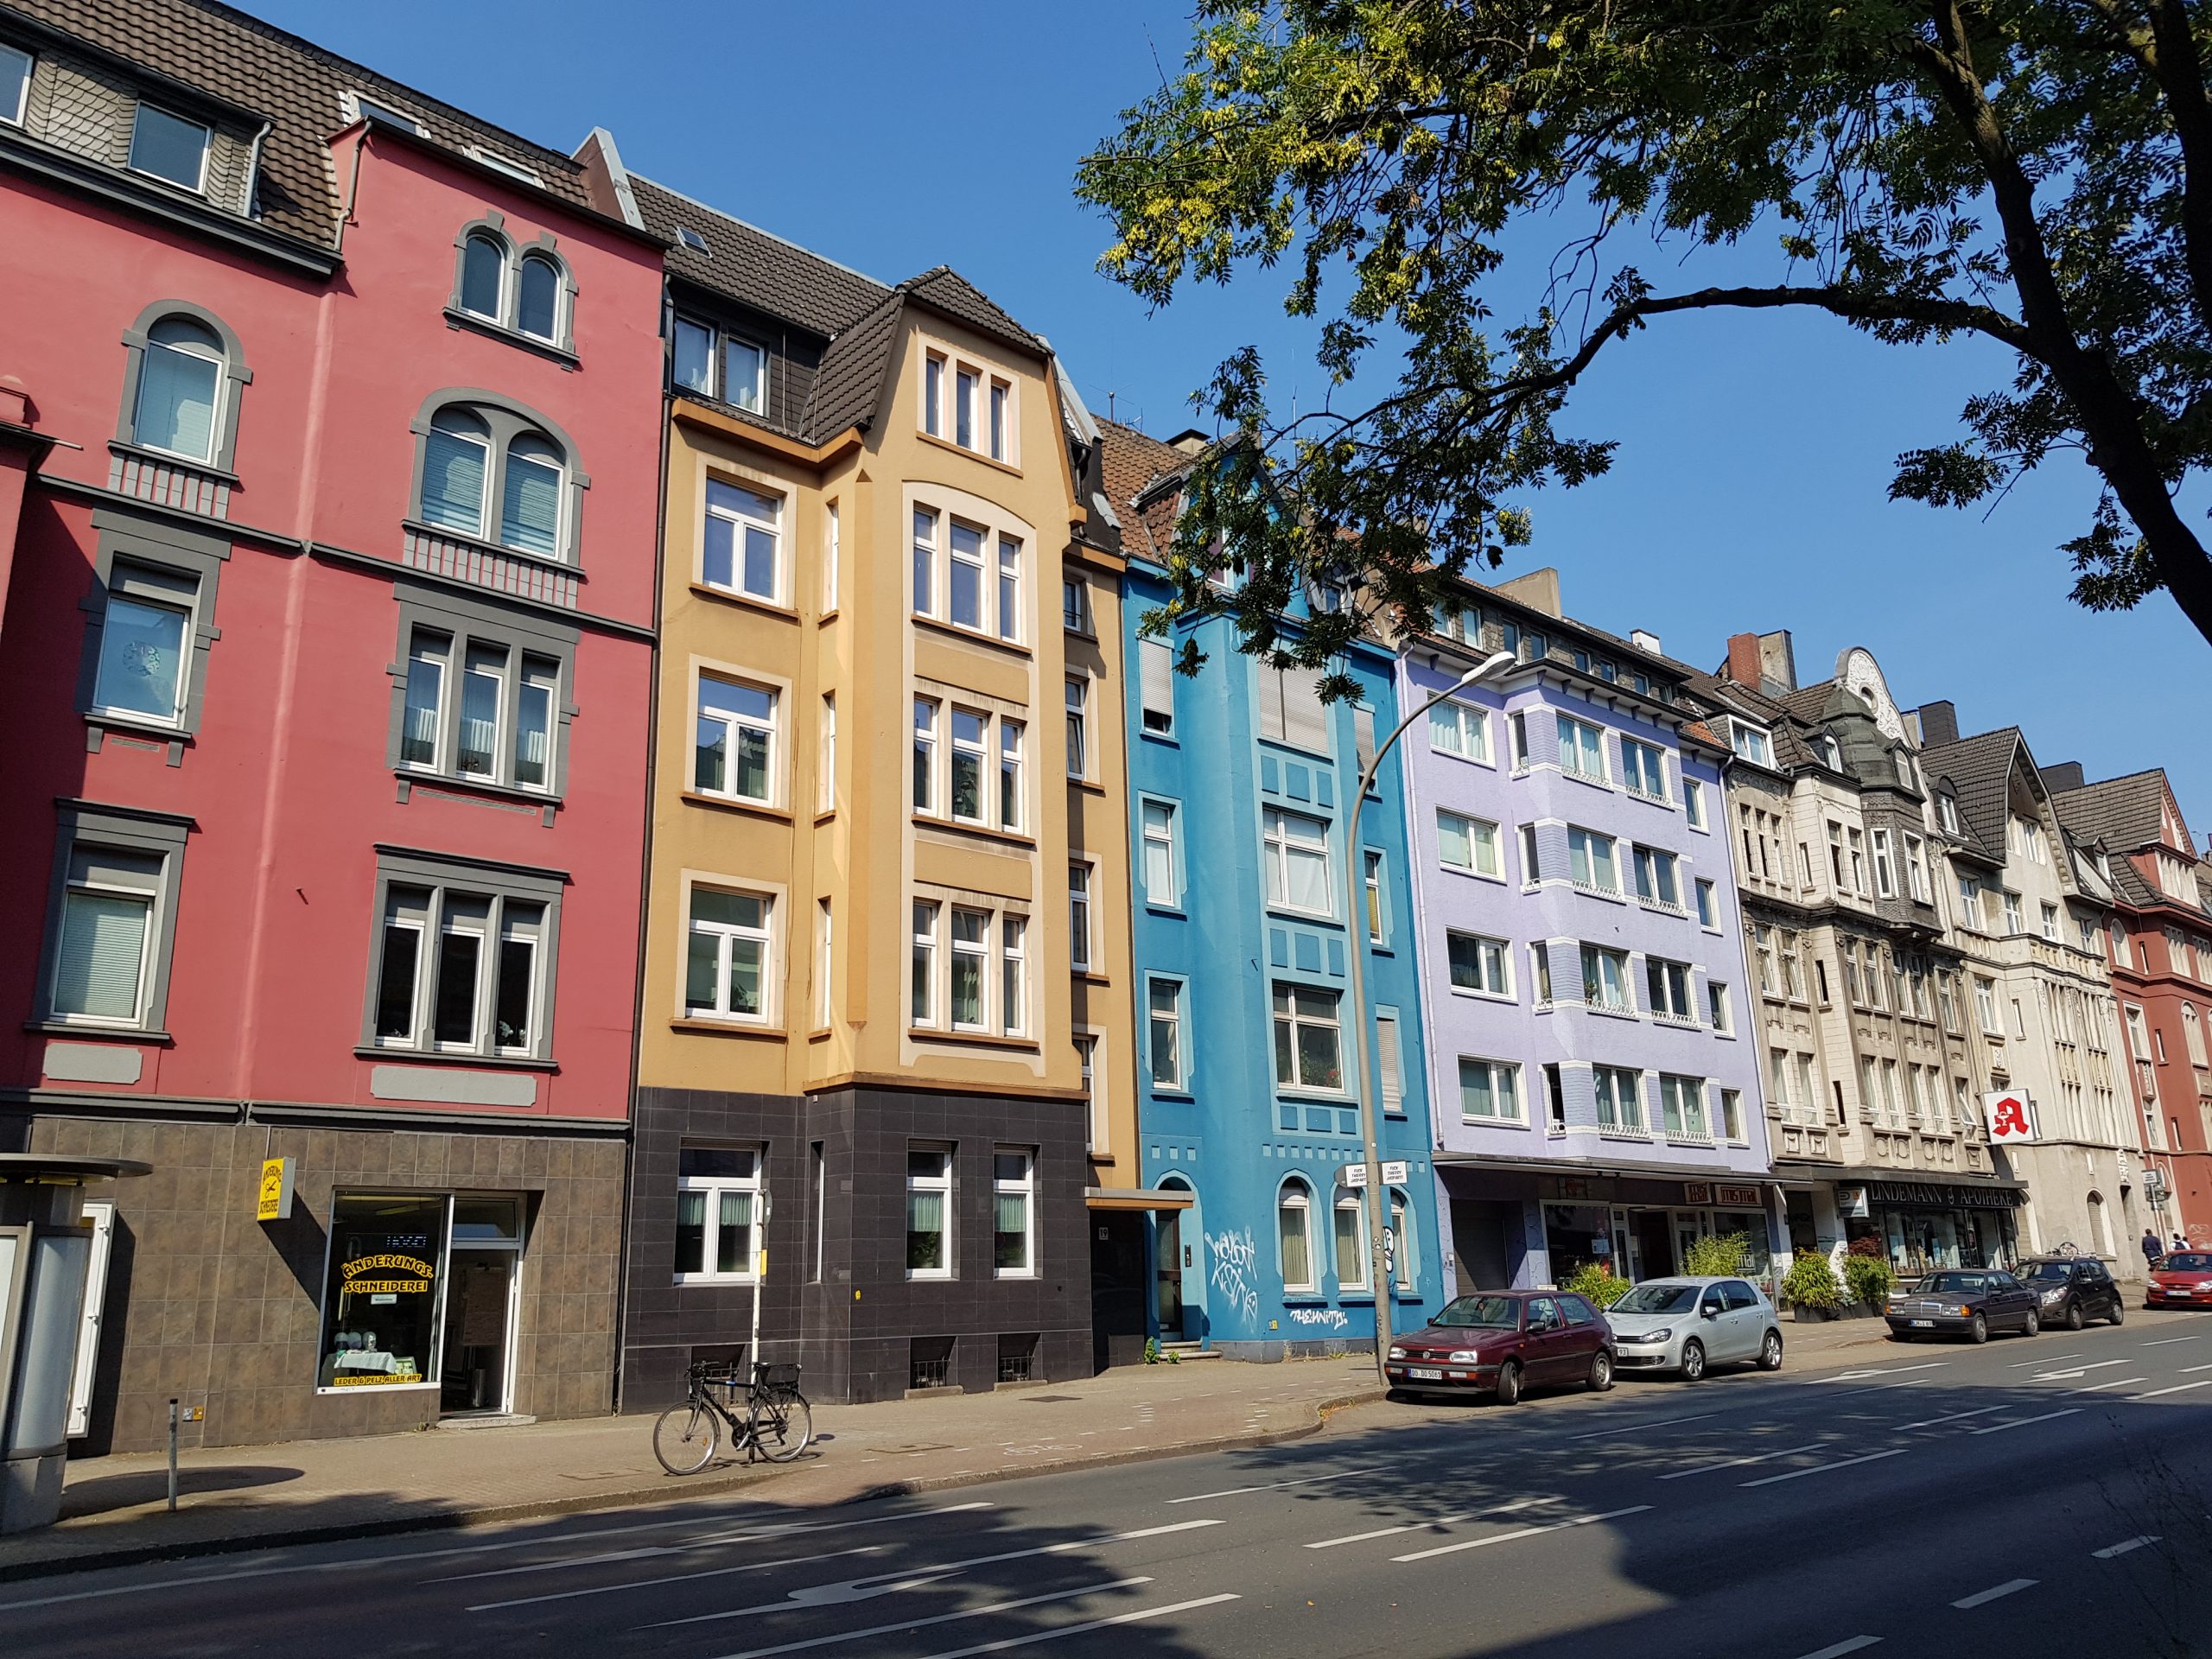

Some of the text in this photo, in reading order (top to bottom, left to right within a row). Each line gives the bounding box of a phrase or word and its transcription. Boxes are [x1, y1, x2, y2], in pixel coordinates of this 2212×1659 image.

[1870, 1182, 2013, 1206] LINDEMANN APOTHEKE
[341, 1255, 434, 1279] ÄNDERUNGS-
[345, 1281, 429, 1294] SCHNEIDEREI
[334, 1377, 358, 1386] LEDER
[366, 1376, 384, 1384] PELZ
[385, 1375, 405, 1383] ALLER
[407, 1373, 422, 1382] ART
